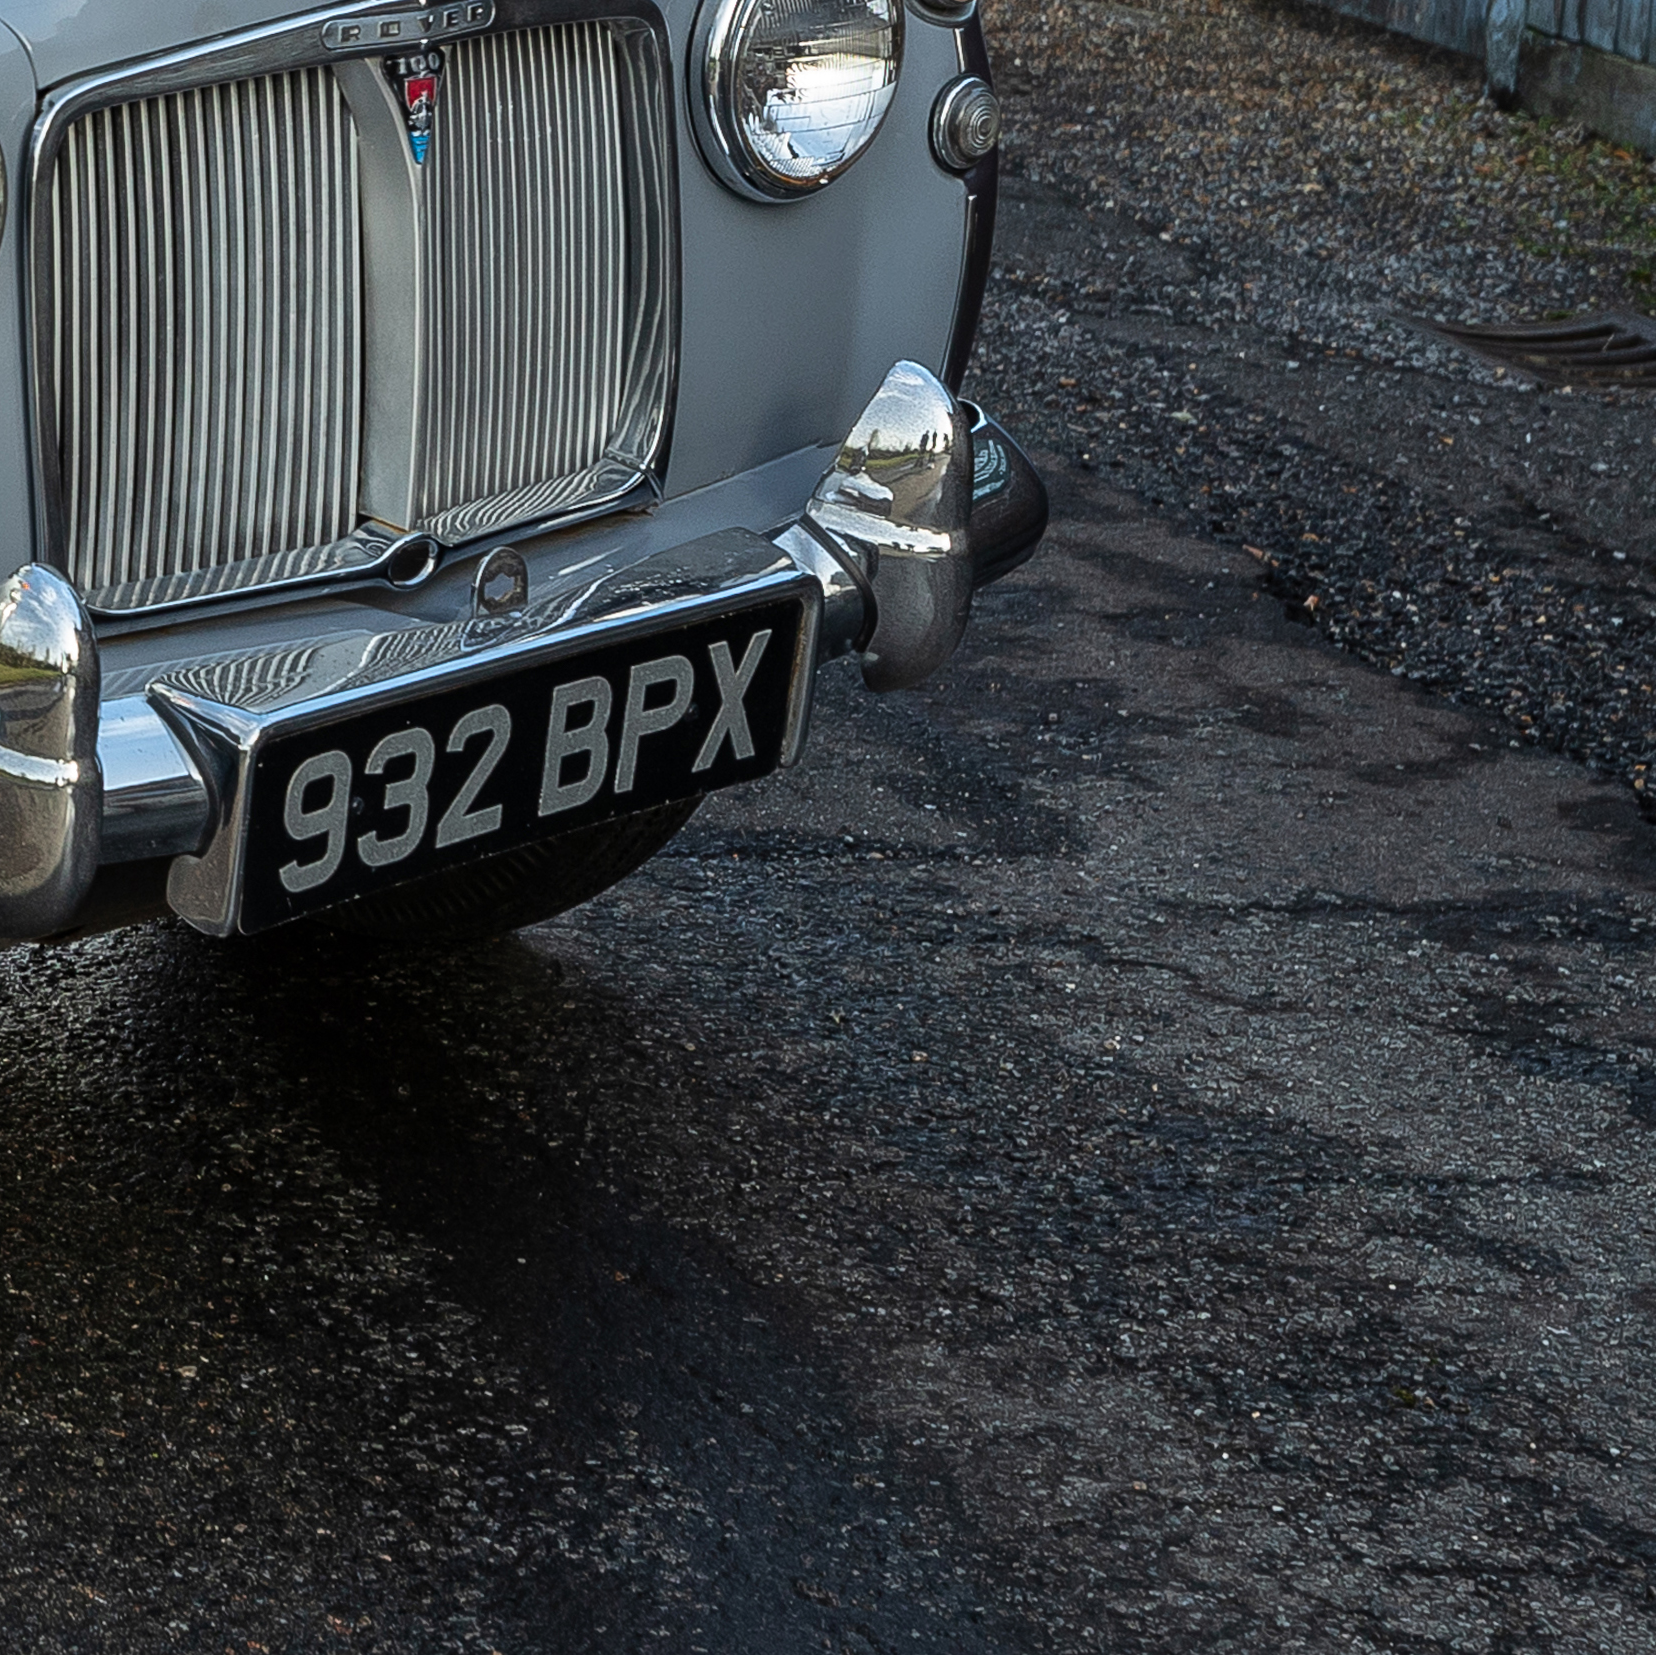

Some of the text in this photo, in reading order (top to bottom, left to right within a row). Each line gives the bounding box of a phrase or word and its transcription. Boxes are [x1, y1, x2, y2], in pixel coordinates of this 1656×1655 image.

[337, 1, 486, 43] ROVER
[397, 52, 441, 75] 100
[278, 629, 774, 893] 932 BPX
